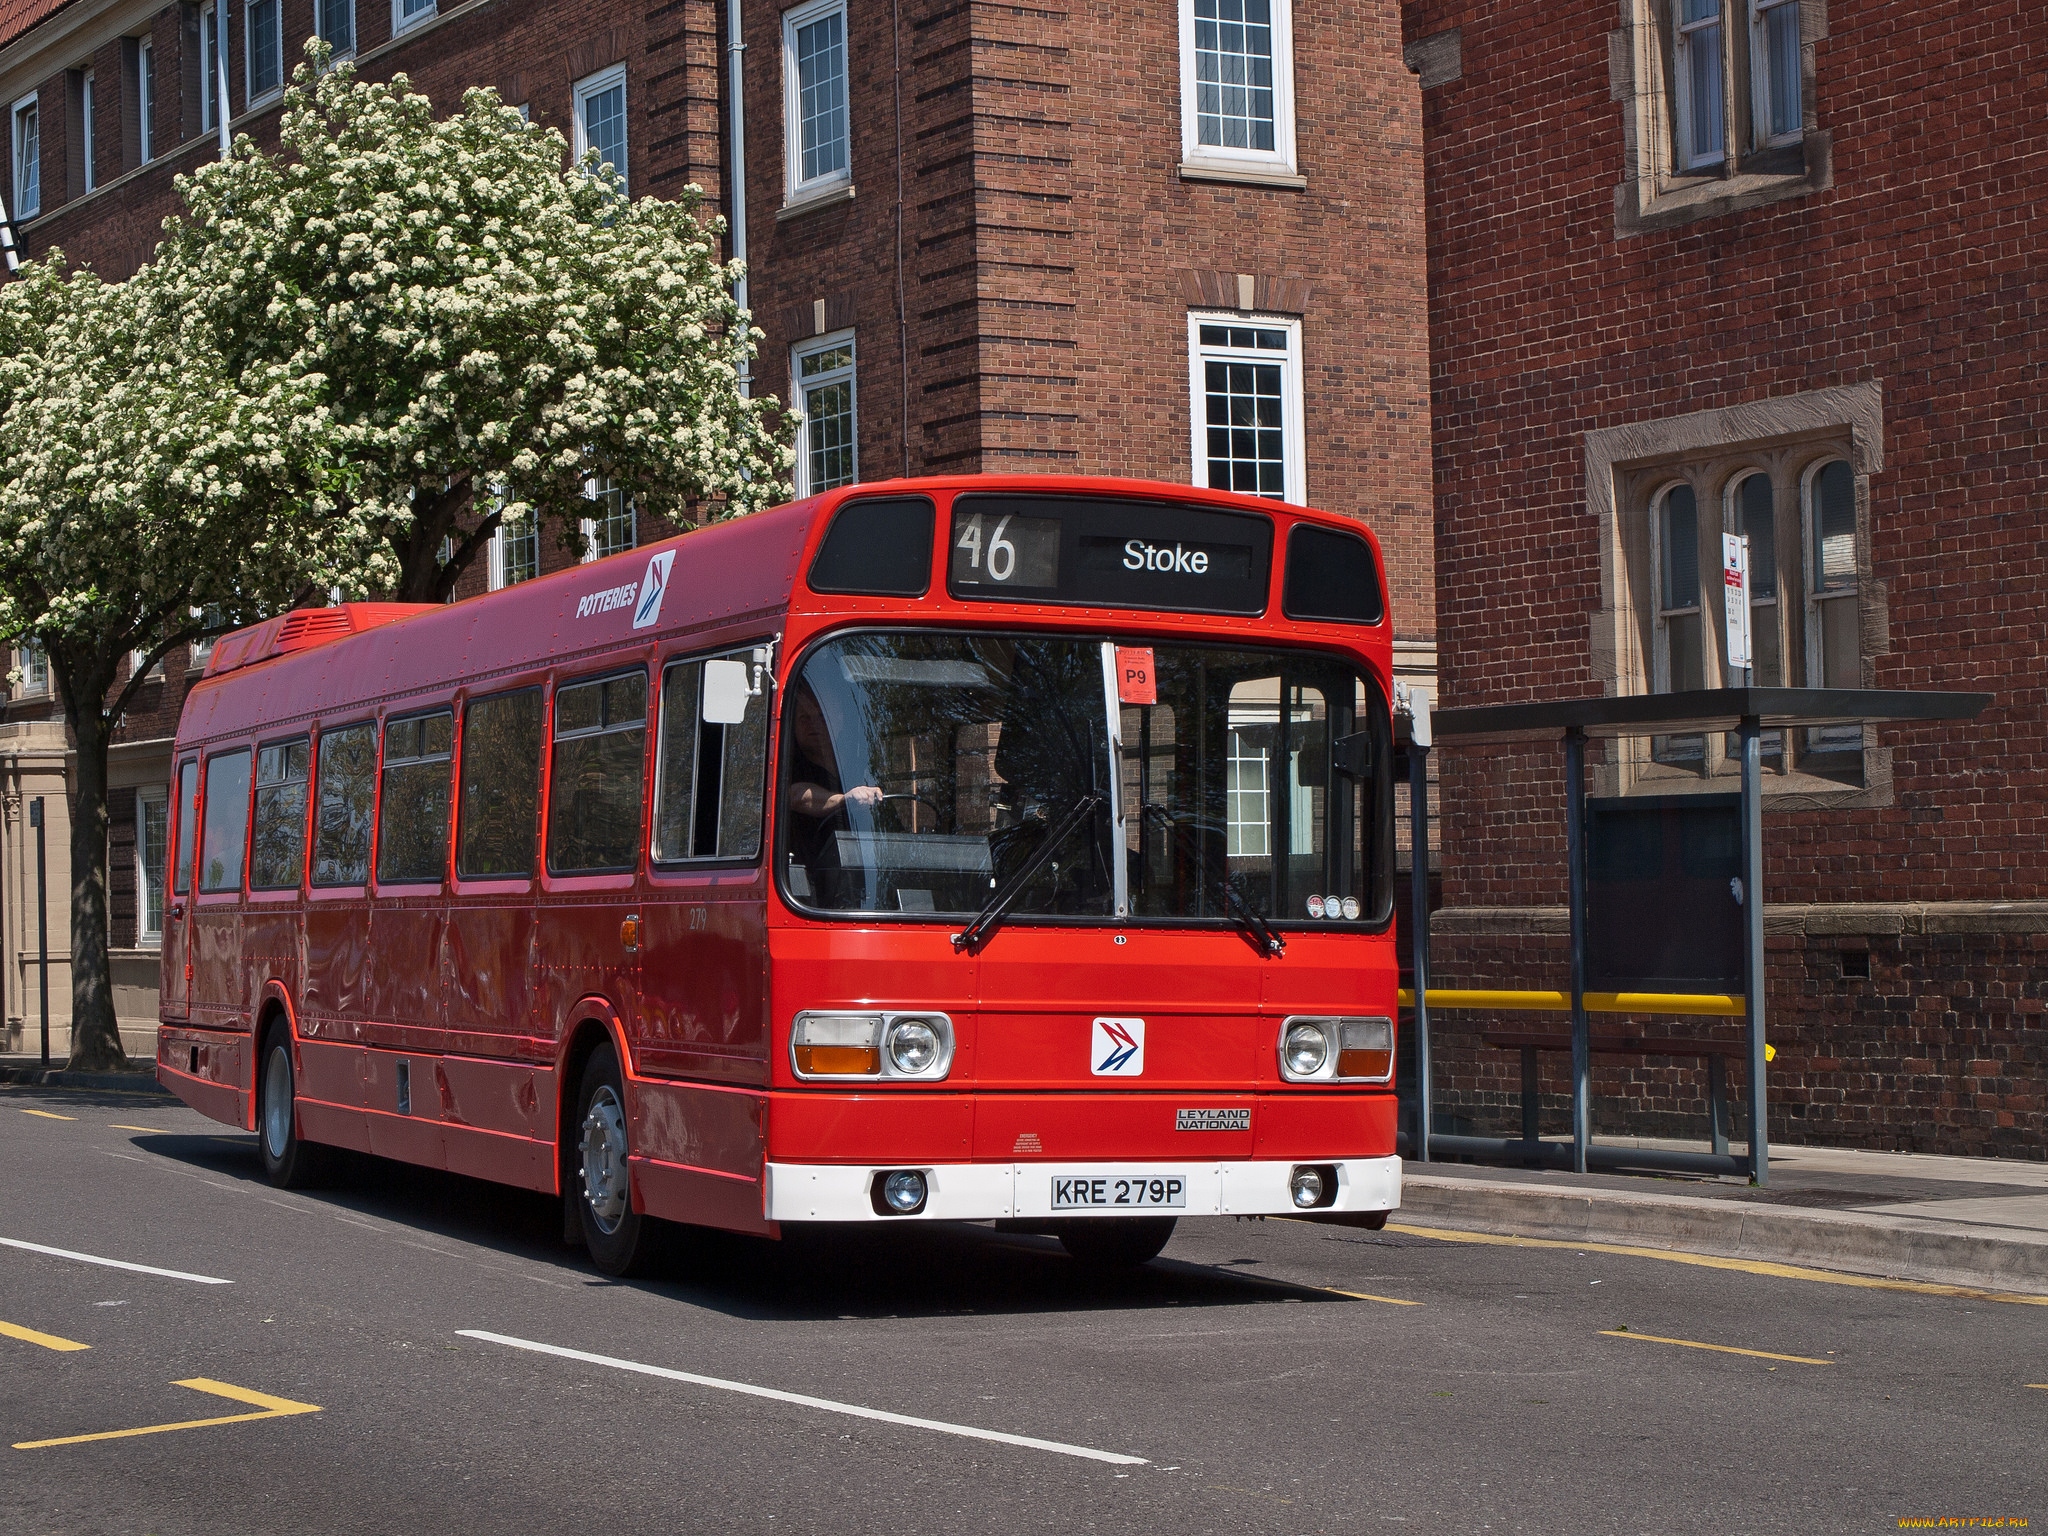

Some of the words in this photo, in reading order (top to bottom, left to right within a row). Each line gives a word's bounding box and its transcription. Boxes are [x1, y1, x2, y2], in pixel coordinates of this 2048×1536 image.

[956, 513, 1016, 581] 46
[1123, 539, 1209, 574] Stoke
[575, 581, 638, 619] POTTERIES
[1126, 669, 1147, 684] P9
[689, 907, 707, 931] 279
[1177, 1120, 1249, 1129] NATIONAL
[1178, 1109, 1250, 1119] LEYLAND
[1056, 1179, 1107, 1204] KRE
[1114, 1179, 1182, 1204] 279P
